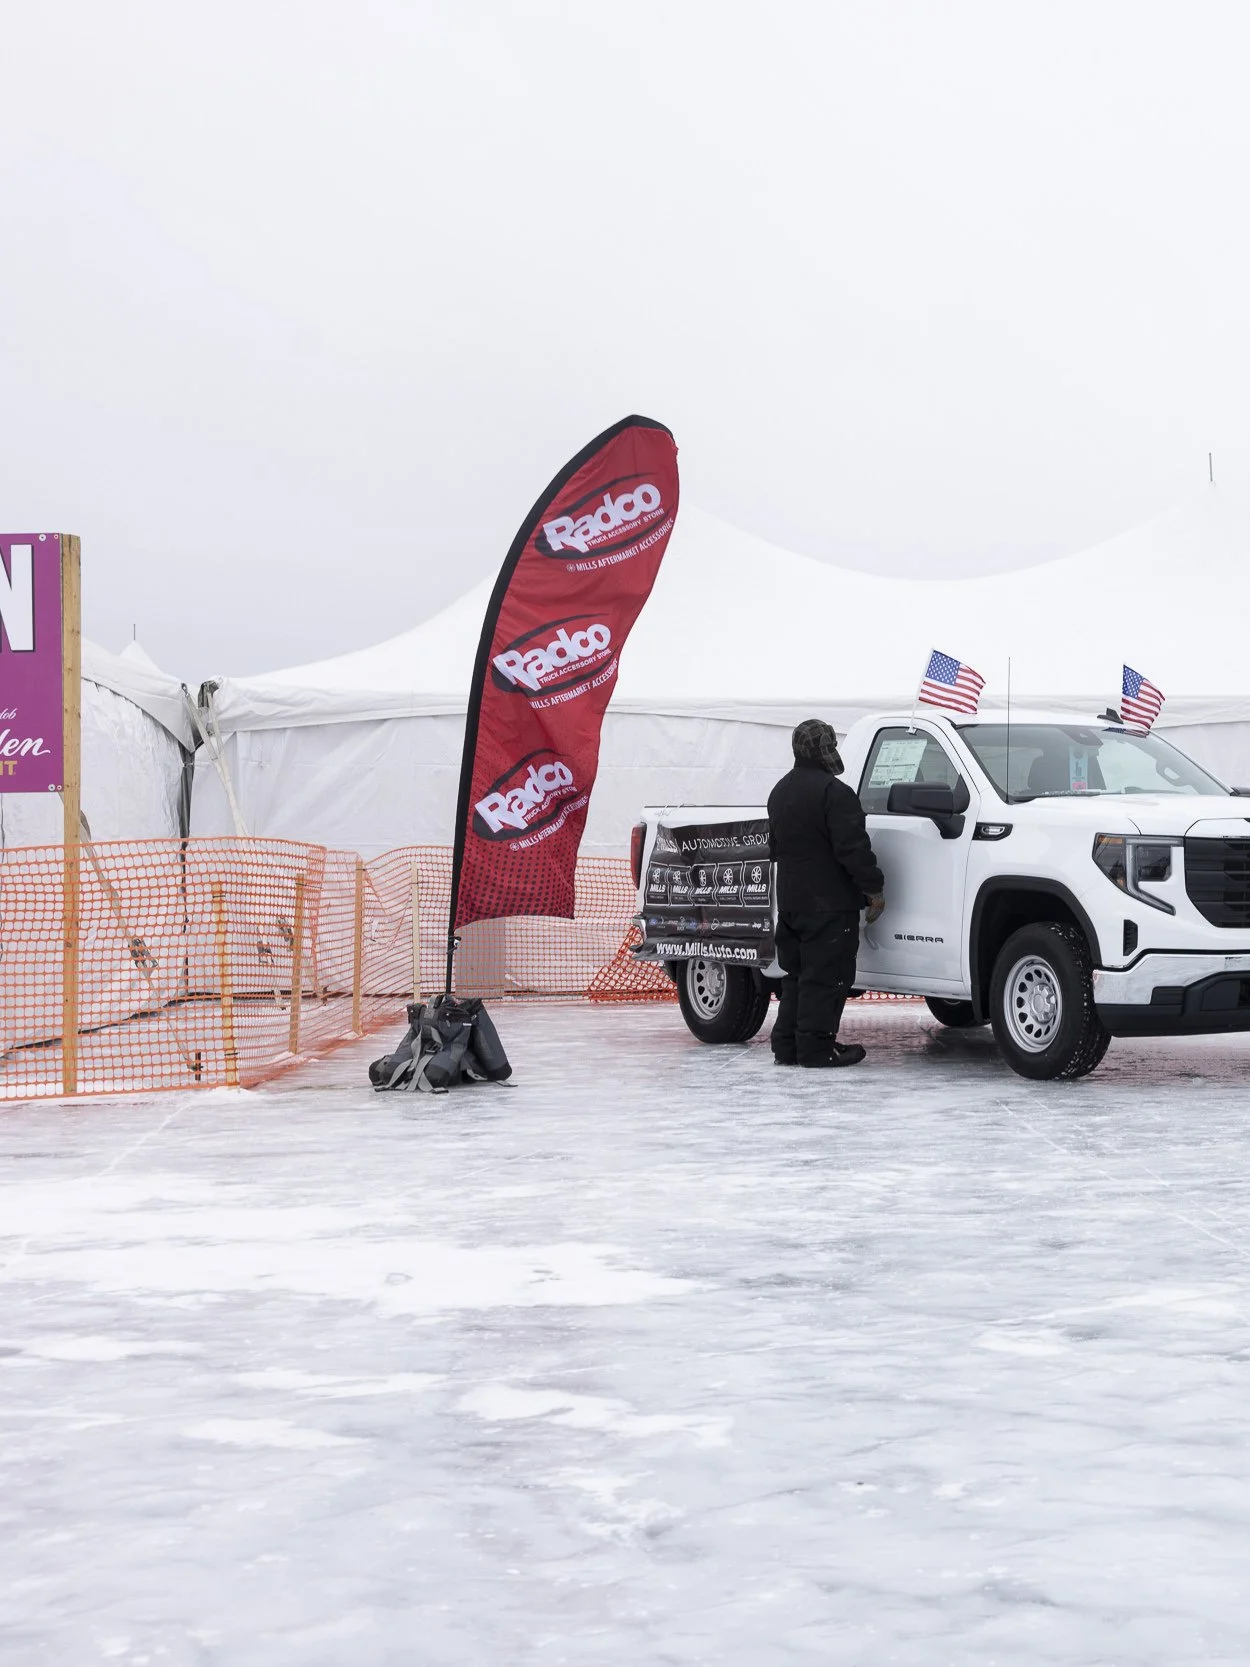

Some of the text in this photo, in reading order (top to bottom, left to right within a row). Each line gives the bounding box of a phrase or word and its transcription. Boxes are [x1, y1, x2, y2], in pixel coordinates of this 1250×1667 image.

[542, 483, 661, 553] Radco
[587, 508, 665, 547] TRUCK ACCESSORY STORE
[576, 560, 598, 572] MILLS
[598, 546, 640, 569] AFTERMARKET
[492, 623, 611, 692] Radco
[539, 648, 612, 684] TRUCK ACCESSORY STORE
[550, 682, 591, 706] AFTERMARKET
[475, 761, 574, 833] Radco
[523, 808, 541, 822] TRUCK
[519, 834, 539, 849] MILLS
[682, 836, 741, 852] AUTOMOTIVE
[746, 883, 766, 893] MILLS
[894, 933, 944, 943] SIERRA
[656, 942, 757, 961] www.MillsAuto.com
